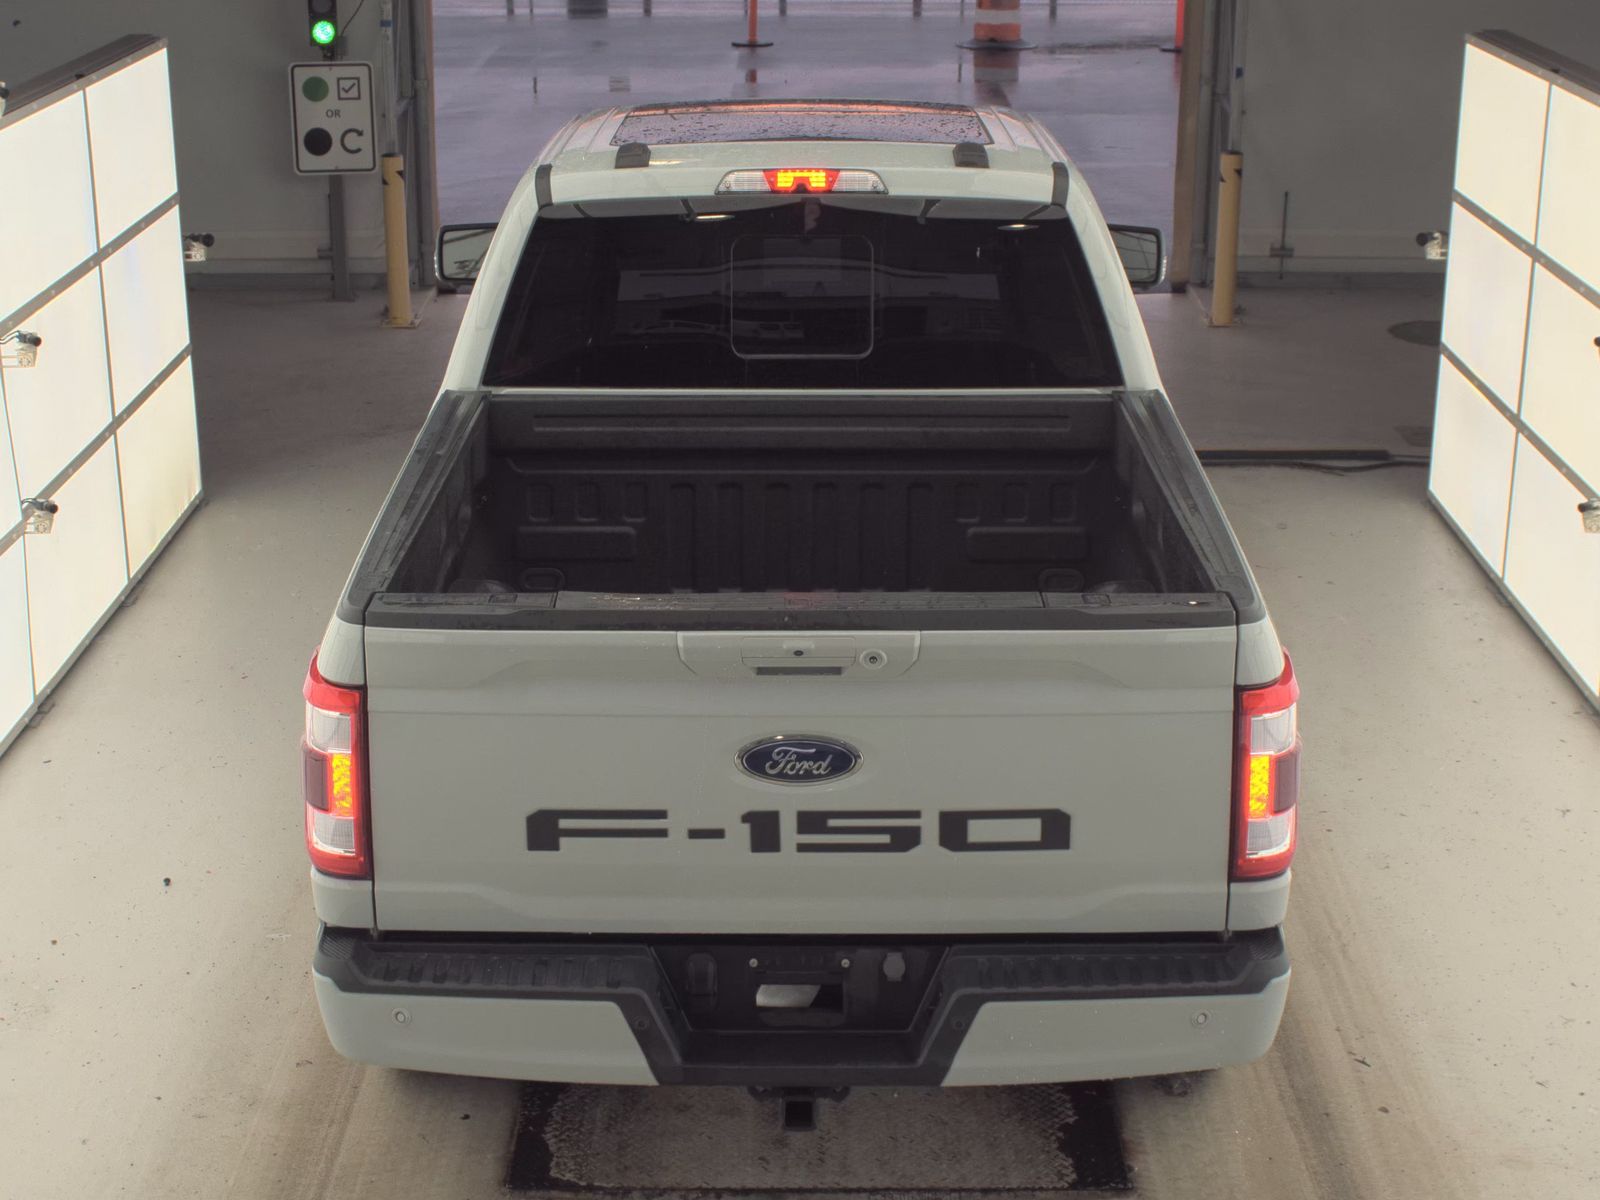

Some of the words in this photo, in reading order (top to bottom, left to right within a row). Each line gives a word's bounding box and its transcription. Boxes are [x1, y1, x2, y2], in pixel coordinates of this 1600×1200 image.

[325, 109, 341, 118] OR
[765, 746, 833, 775] Ford
[526, 809, 1071, 853] F-150
